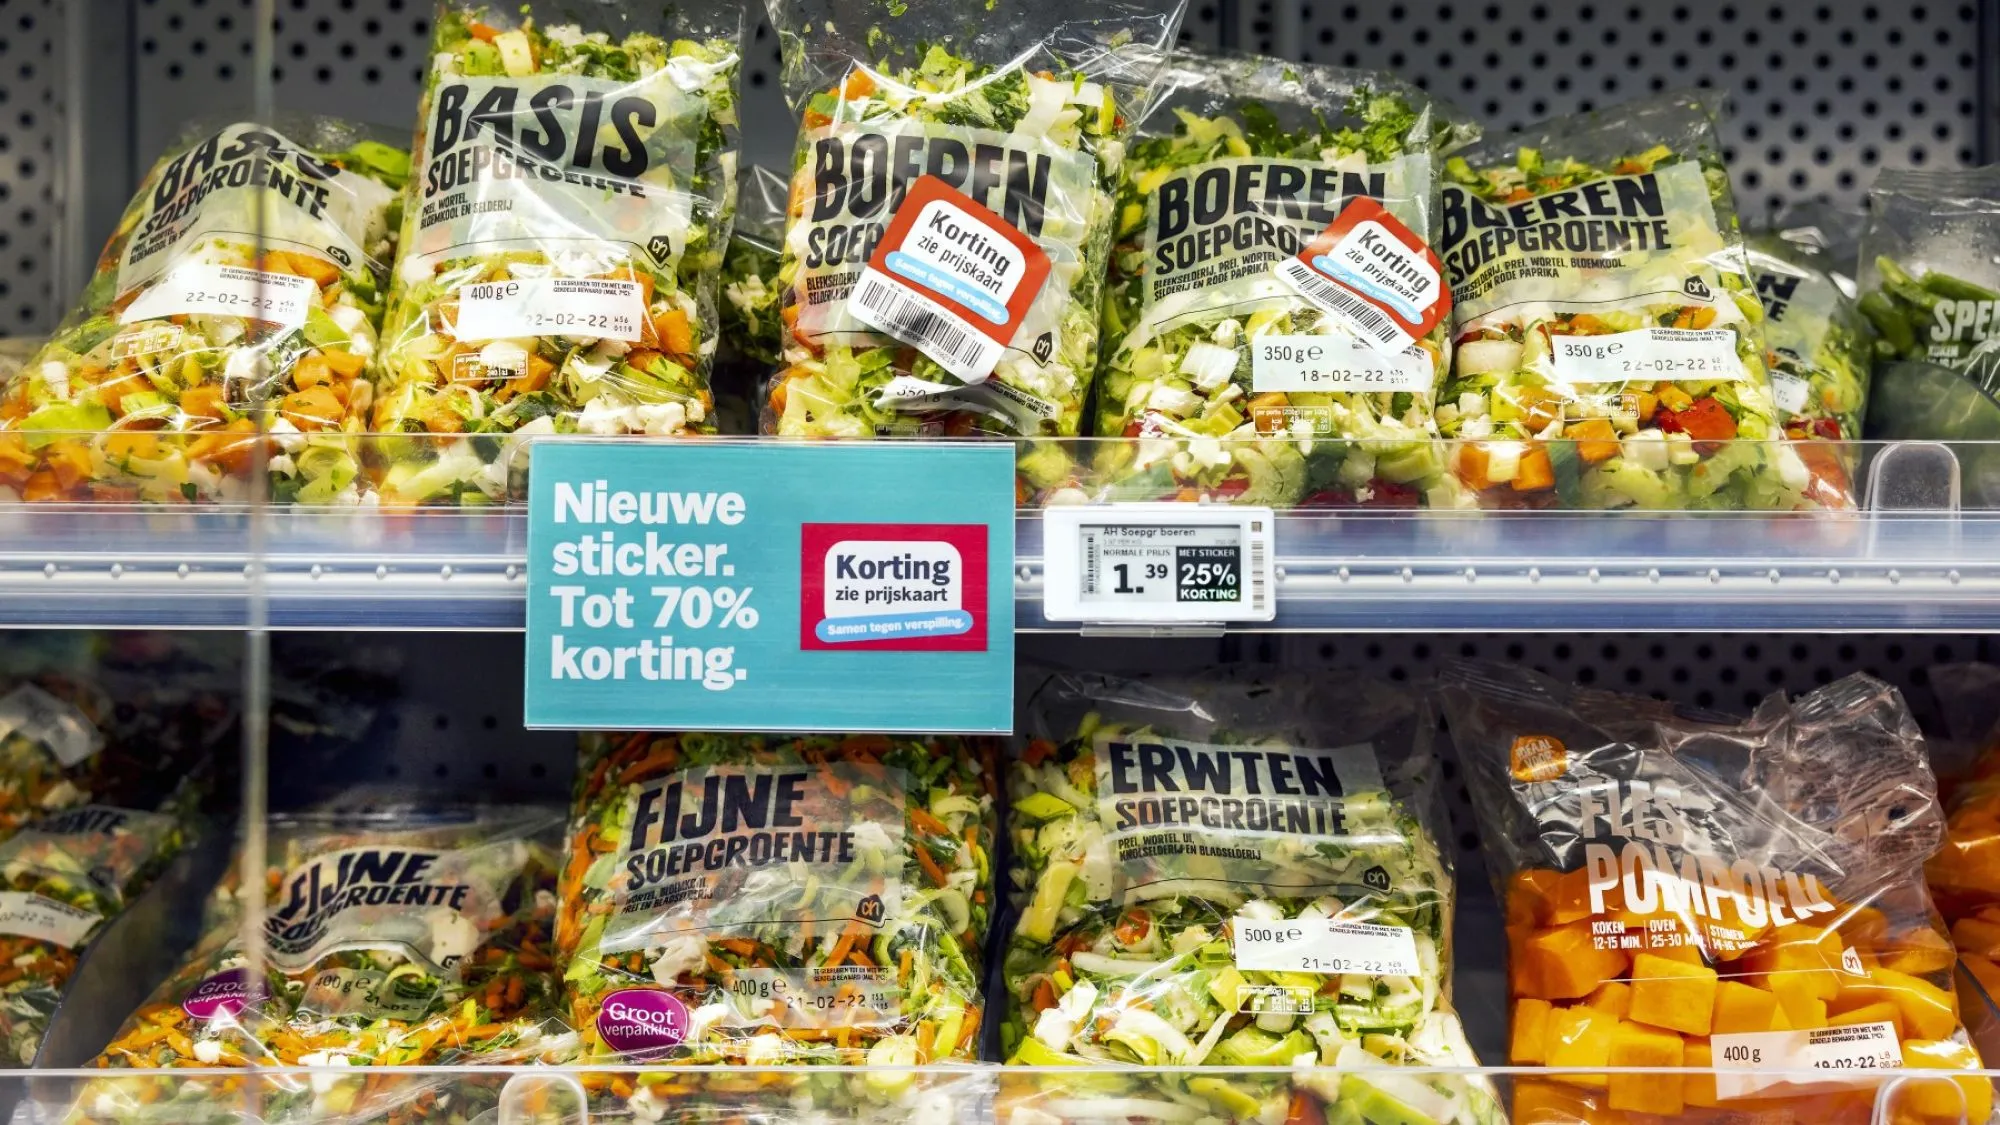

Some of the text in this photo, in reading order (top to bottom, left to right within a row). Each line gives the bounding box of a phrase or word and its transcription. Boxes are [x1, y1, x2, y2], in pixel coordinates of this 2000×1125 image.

[433, 84, 657, 178] BASIS
[137, 158, 330, 241] SOEPGROENTE
[460, 203, 471, 216] EN
[473, 199, 513, 214] SELDERIJ
[928, 209, 1012, 277] Korting
[1357, 228, 1432, 294] Korting
[1445, 219, 1672, 287] SOEPGROENTE
[917, 235, 1003, 295] zie prijskaart
[1154, 262, 1270, 302] SELDERIJ EN RODE PAPRIKA
[1345, 248, 1365, 265] zie
[1362, 262, 1419, 303] prijskaart
[1493, 271, 1517, 286] RODE
[1519, 267, 1560, 279] PAPRIKA
[185, 291, 273, 310] 22-02-22
[470, 285, 504, 301] 400 g
[525, 313, 608, 328] 22-02-22
[1264, 345, 1305, 363] 350 g
[1564, 344, 1605, 359] 350 g
[1300, 369, 1384, 382] 18-02-22
[553, 479, 747, 527] Nieuwe
[1103, 527, 1196, 538] AH Soepgr boeren
[551, 531, 735, 577] sticker.
[1103, 549, 1171, 557] NORMALE PRIJS
[1178, 549, 1235, 557] MET STICKER
[836, 553, 951, 587] Korting
[1180, 562, 1236, 586] 25%
[835, 586, 948, 605] zie prijskaart
[1180, 588, 1238, 600] KORTING
[550, 585, 760, 630] Tot 70%
[827, 623, 867, 636] Samen
[869, 620, 902, 634] tegen
[551, 635, 747, 692] korting.
[1108, 741, 1344, 797] ERWTEN
[628, 772, 808, 853] FIJNE
[1115, 796, 1350, 836] SOEPGROENTE
[1578, 779, 1685, 848] FLES
[626, 831, 856, 892] SOEPGROENTE
[1185, 844, 1197, 855] EN
[1199, 845, 1262, 861] BLADSELDERIJ
[278, 850, 439, 921] FIJNE
[1585, 843, 1837, 930] POMPOEN
[1591, 921, 1626, 935] KOKEN
[1649, 918, 1677, 933] OVEN
[1709, 924, 1745, 941] STOMEN
[1244, 928, 1285, 943] 500 g
[1593, 935, 1643, 950] 12-15 MIN.
[1651, 934, 1682, 948] 25-30
[1302, 957, 1383, 972] 21-02-22
[314, 975, 341, 991] 400
[732, 979, 769, 998] 400 g
[787, 994, 866, 1009] 21-02-22
[606, 1002, 674, 1026] Groot
[604, 1022, 680, 1041] verpakking
[1831, 1036, 1856, 1044] BEWAARD
[1723, 1045, 1761, 1063] 400 g
